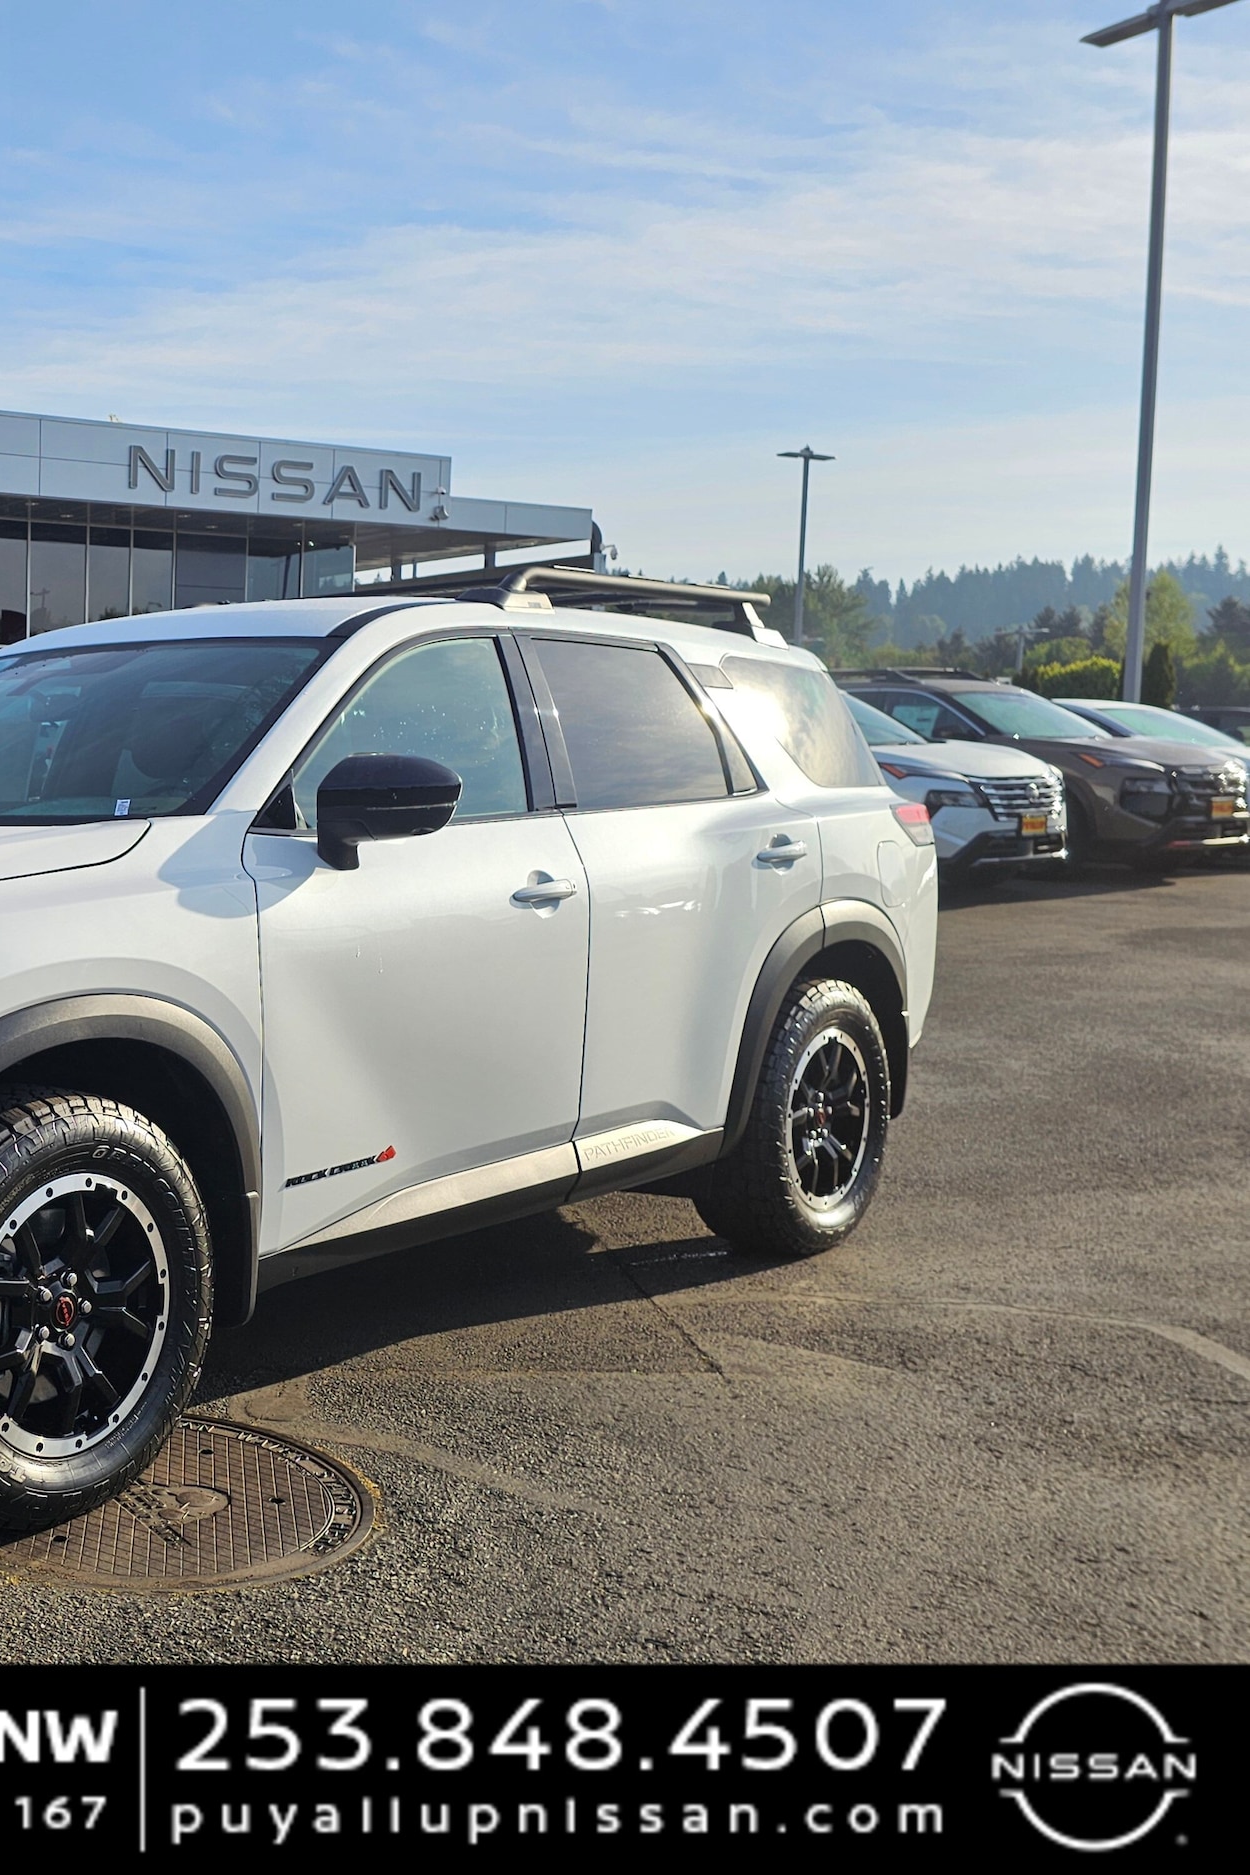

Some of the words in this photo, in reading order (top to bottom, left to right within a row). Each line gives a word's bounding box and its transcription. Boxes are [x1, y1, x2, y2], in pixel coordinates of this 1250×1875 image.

[128, 444, 423, 512] NISSAN
[284, 1167, 330, 1189] ROCK
[329, 1153, 378, 1177] CREEK
